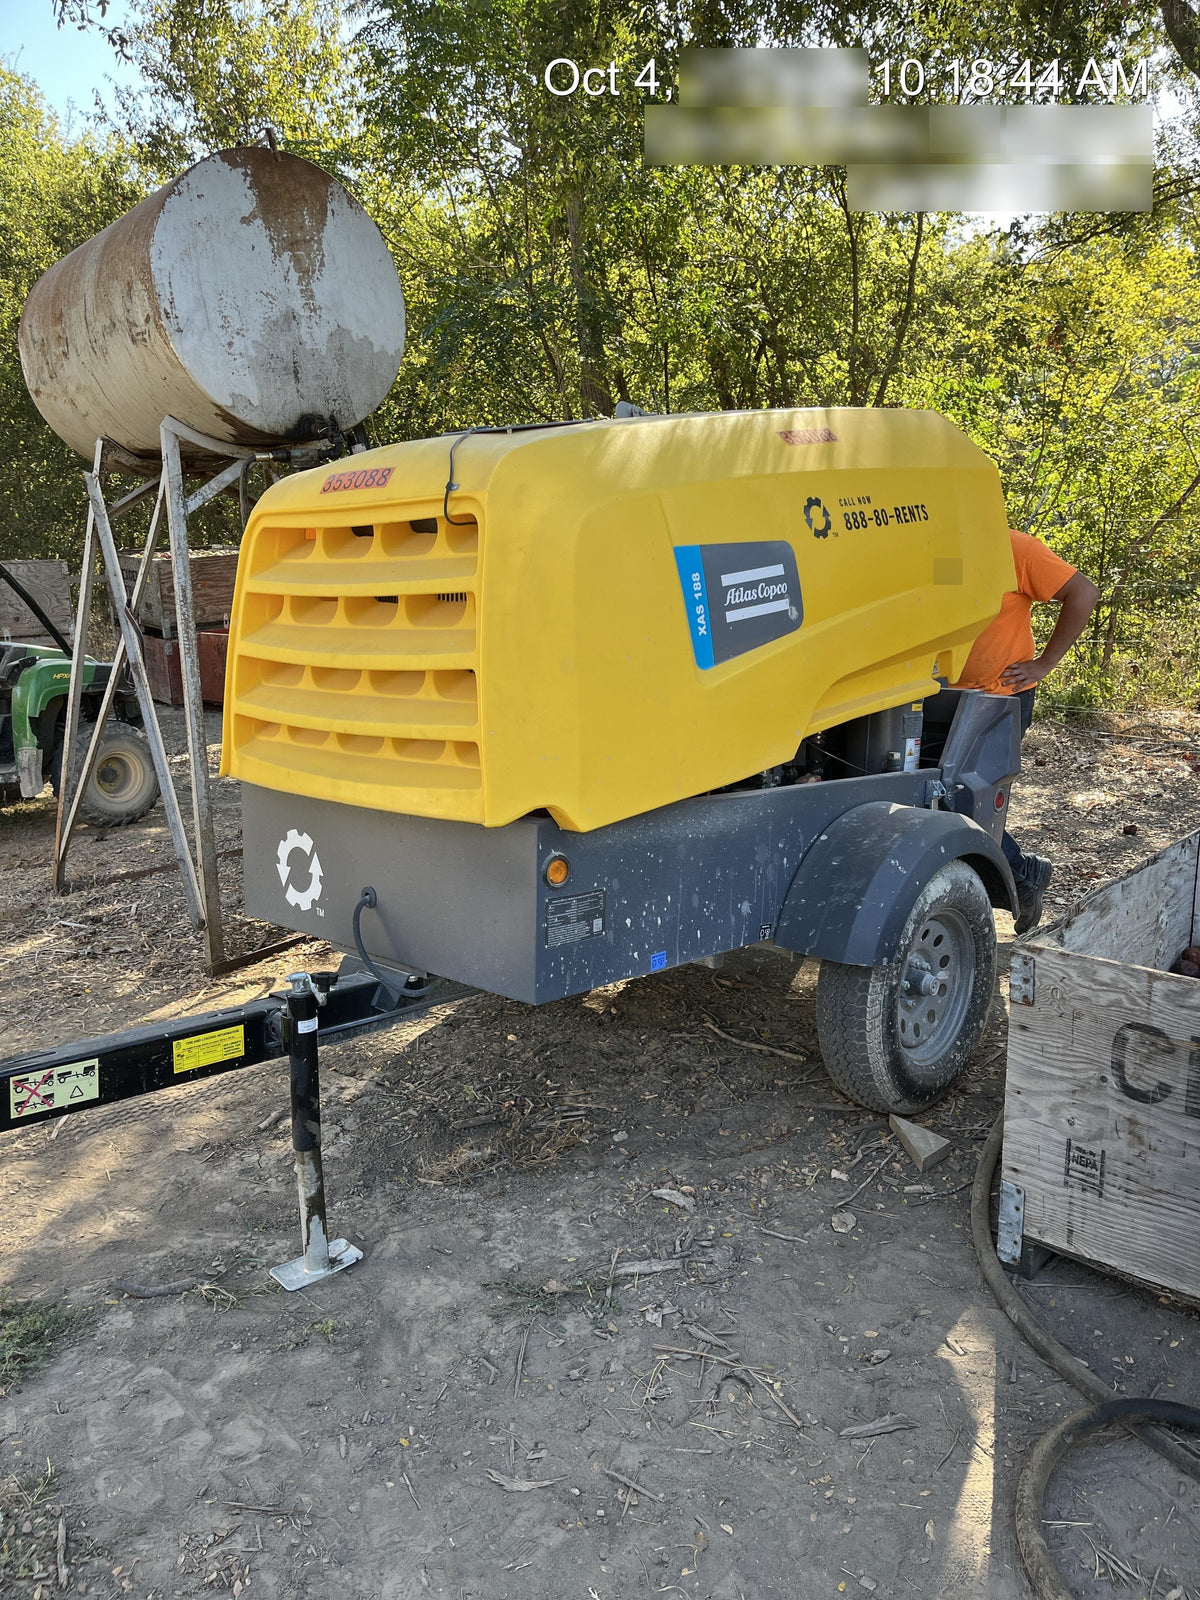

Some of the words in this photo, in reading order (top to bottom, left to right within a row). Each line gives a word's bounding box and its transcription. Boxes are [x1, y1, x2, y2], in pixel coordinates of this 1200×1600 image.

[322, 467, 392, 493] 353088
[838, 497, 856, 507] CALL
[857, 495, 872, 505] NOW
[843, 504, 929, 531] 888-80-RENTS
[691, 572, 703, 600] 188
[695, 604, 707, 636] XAS
[1111, 1021, 1200, 1119] C
